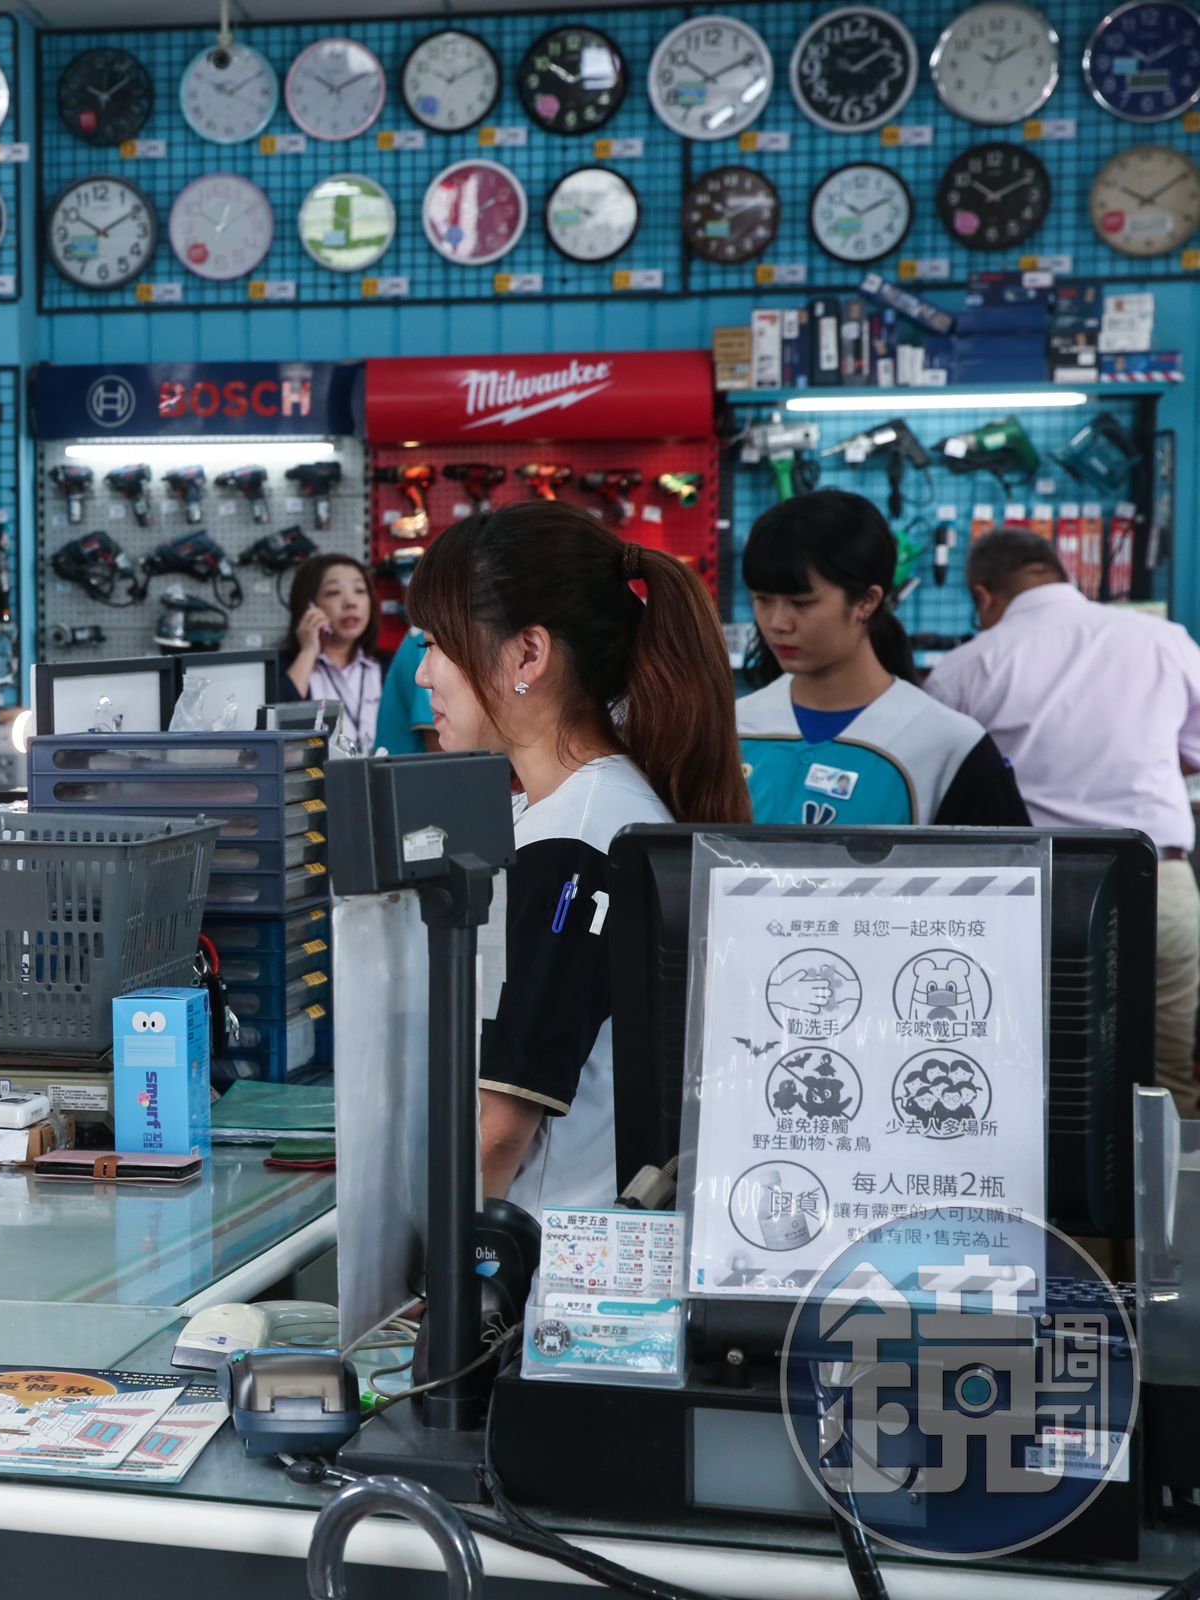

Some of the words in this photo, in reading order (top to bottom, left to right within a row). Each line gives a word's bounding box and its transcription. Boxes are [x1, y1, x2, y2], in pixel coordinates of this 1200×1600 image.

[842, 16, 869, 40] 12
[566, 34, 581, 51] 12
[686, 34, 700, 52] 11
[704, 29, 722, 46] 12
[534, 56, 550, 71] 10
[666, 49, 688, 68] 10
[888, 52, 904, 80] 3
[660, 68, 674, 85] 9
[801, 60, 821, 84] 9
[827, 95, 842, 117] 7
[842, 96, 862, 122] 6
[77, 192, 89, 208] 11
[92, 184, 110, 202] 12
[120, 189, 126, 206] 1
[62, 206, 80, 225] 10
[57, 225, 69, 242] 9
[136, 222, 148, 239] 3
[130, 242, 142, 257] 4
[97, 263, 109, 280] 6
[118, 255, 129, 274] 5
[458, 358, 612, 416] Milwaukee
[159, 380, 312, 417] BOSCH
[790, 920, 839, 932] 振宇五金
[853, 920, 987, 937] 與您一起來防疫
[787, 1018, 840, 1036] 勤洗手
[895, 1020, 988, 1038] 咳嗽戴口罩
[146, 1071, 162, 1129] smurf
[776, 1117, 849, 1135] 避免接觸
[885, 1119, 998, 1137] 少去人多場所
[752, 1134, 872, 1152] 野生動物、禽鳥
[852, 1171, 1006, 1199] 每人限購2瓶
[567, 1214, 608, 1227] 振宇五金
[833, 1203, 1024, 1225] 讓有需要的人可以購買
[592, 1325, 628, 1336] 振宇五金
